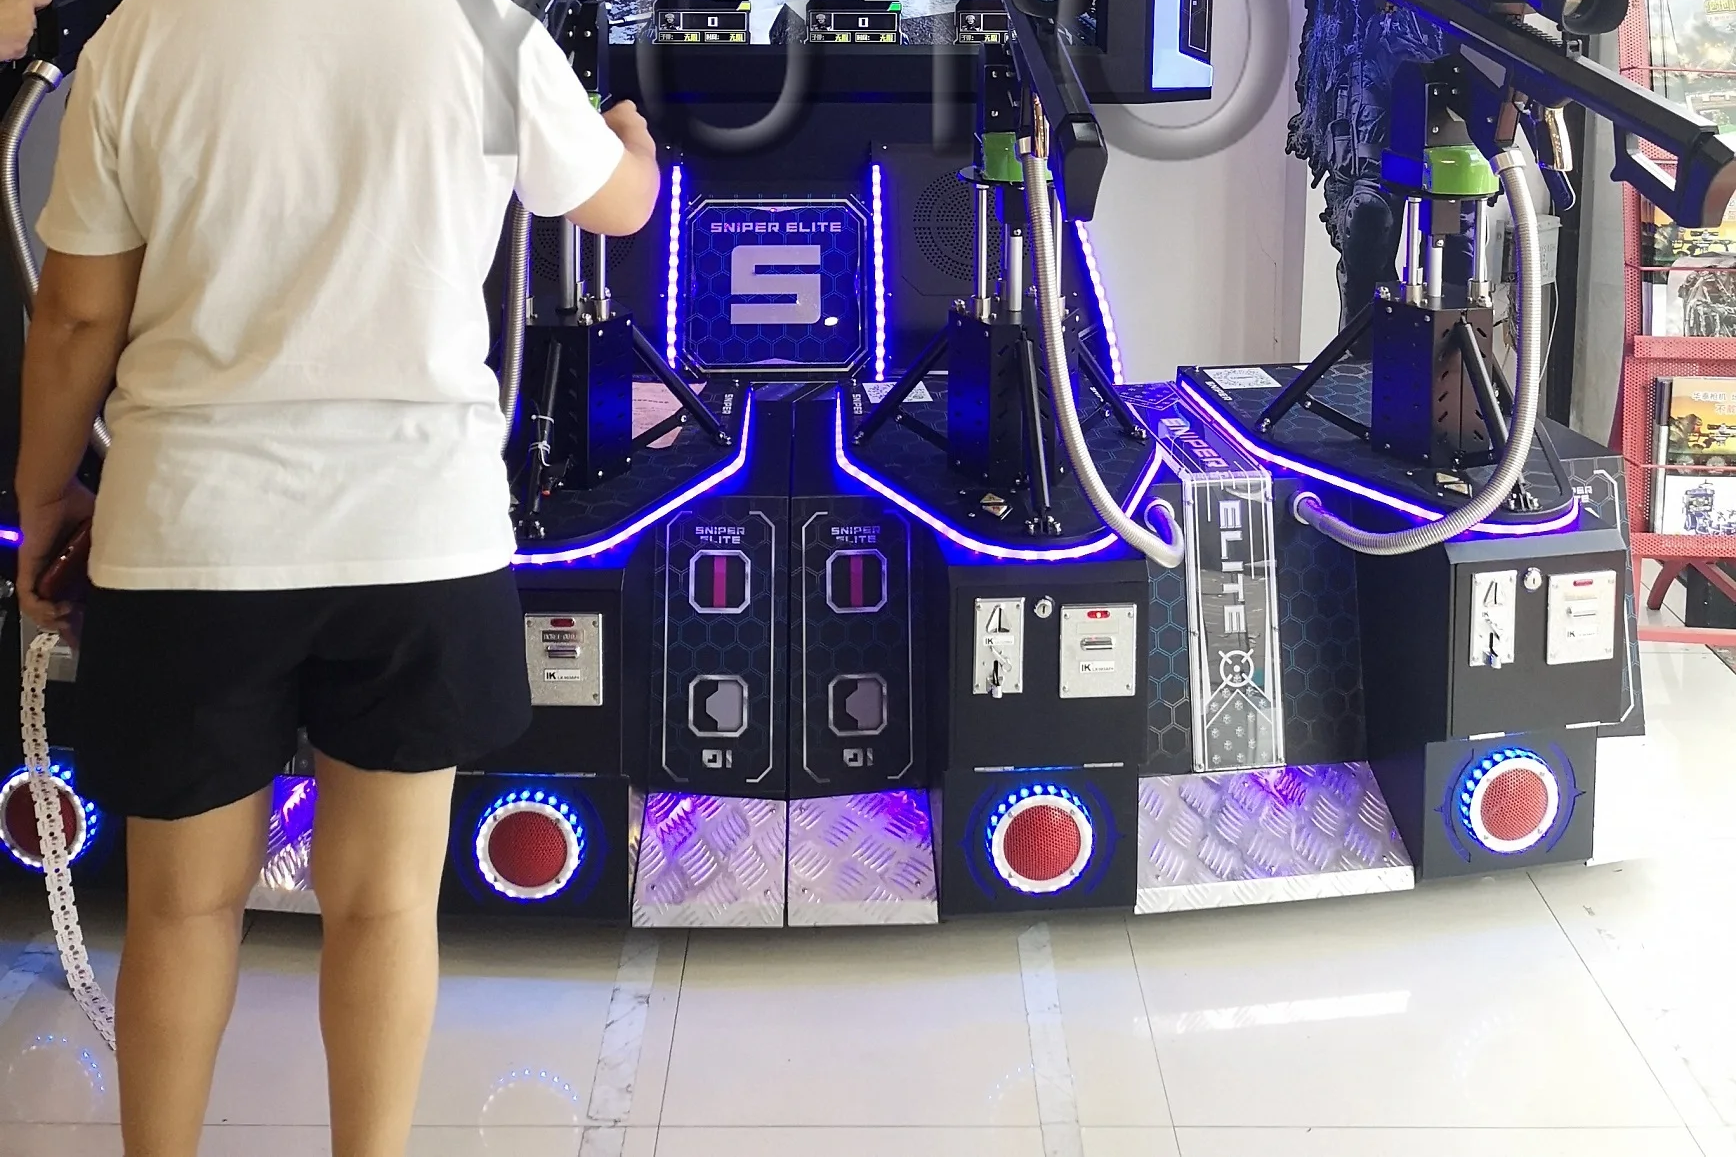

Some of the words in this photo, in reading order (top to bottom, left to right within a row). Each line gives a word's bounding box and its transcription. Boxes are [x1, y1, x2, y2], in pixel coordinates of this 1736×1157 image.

[711, 222, 779, 233] SNIPER
[786, 222, 841, 232] ELITE
[695, 526, 745, 535] SNIPER
[831, 526, 881, 535] SNIPER
[1219, 499, 1247, 634] ELITE
[546, 672, 556, 680] IK
